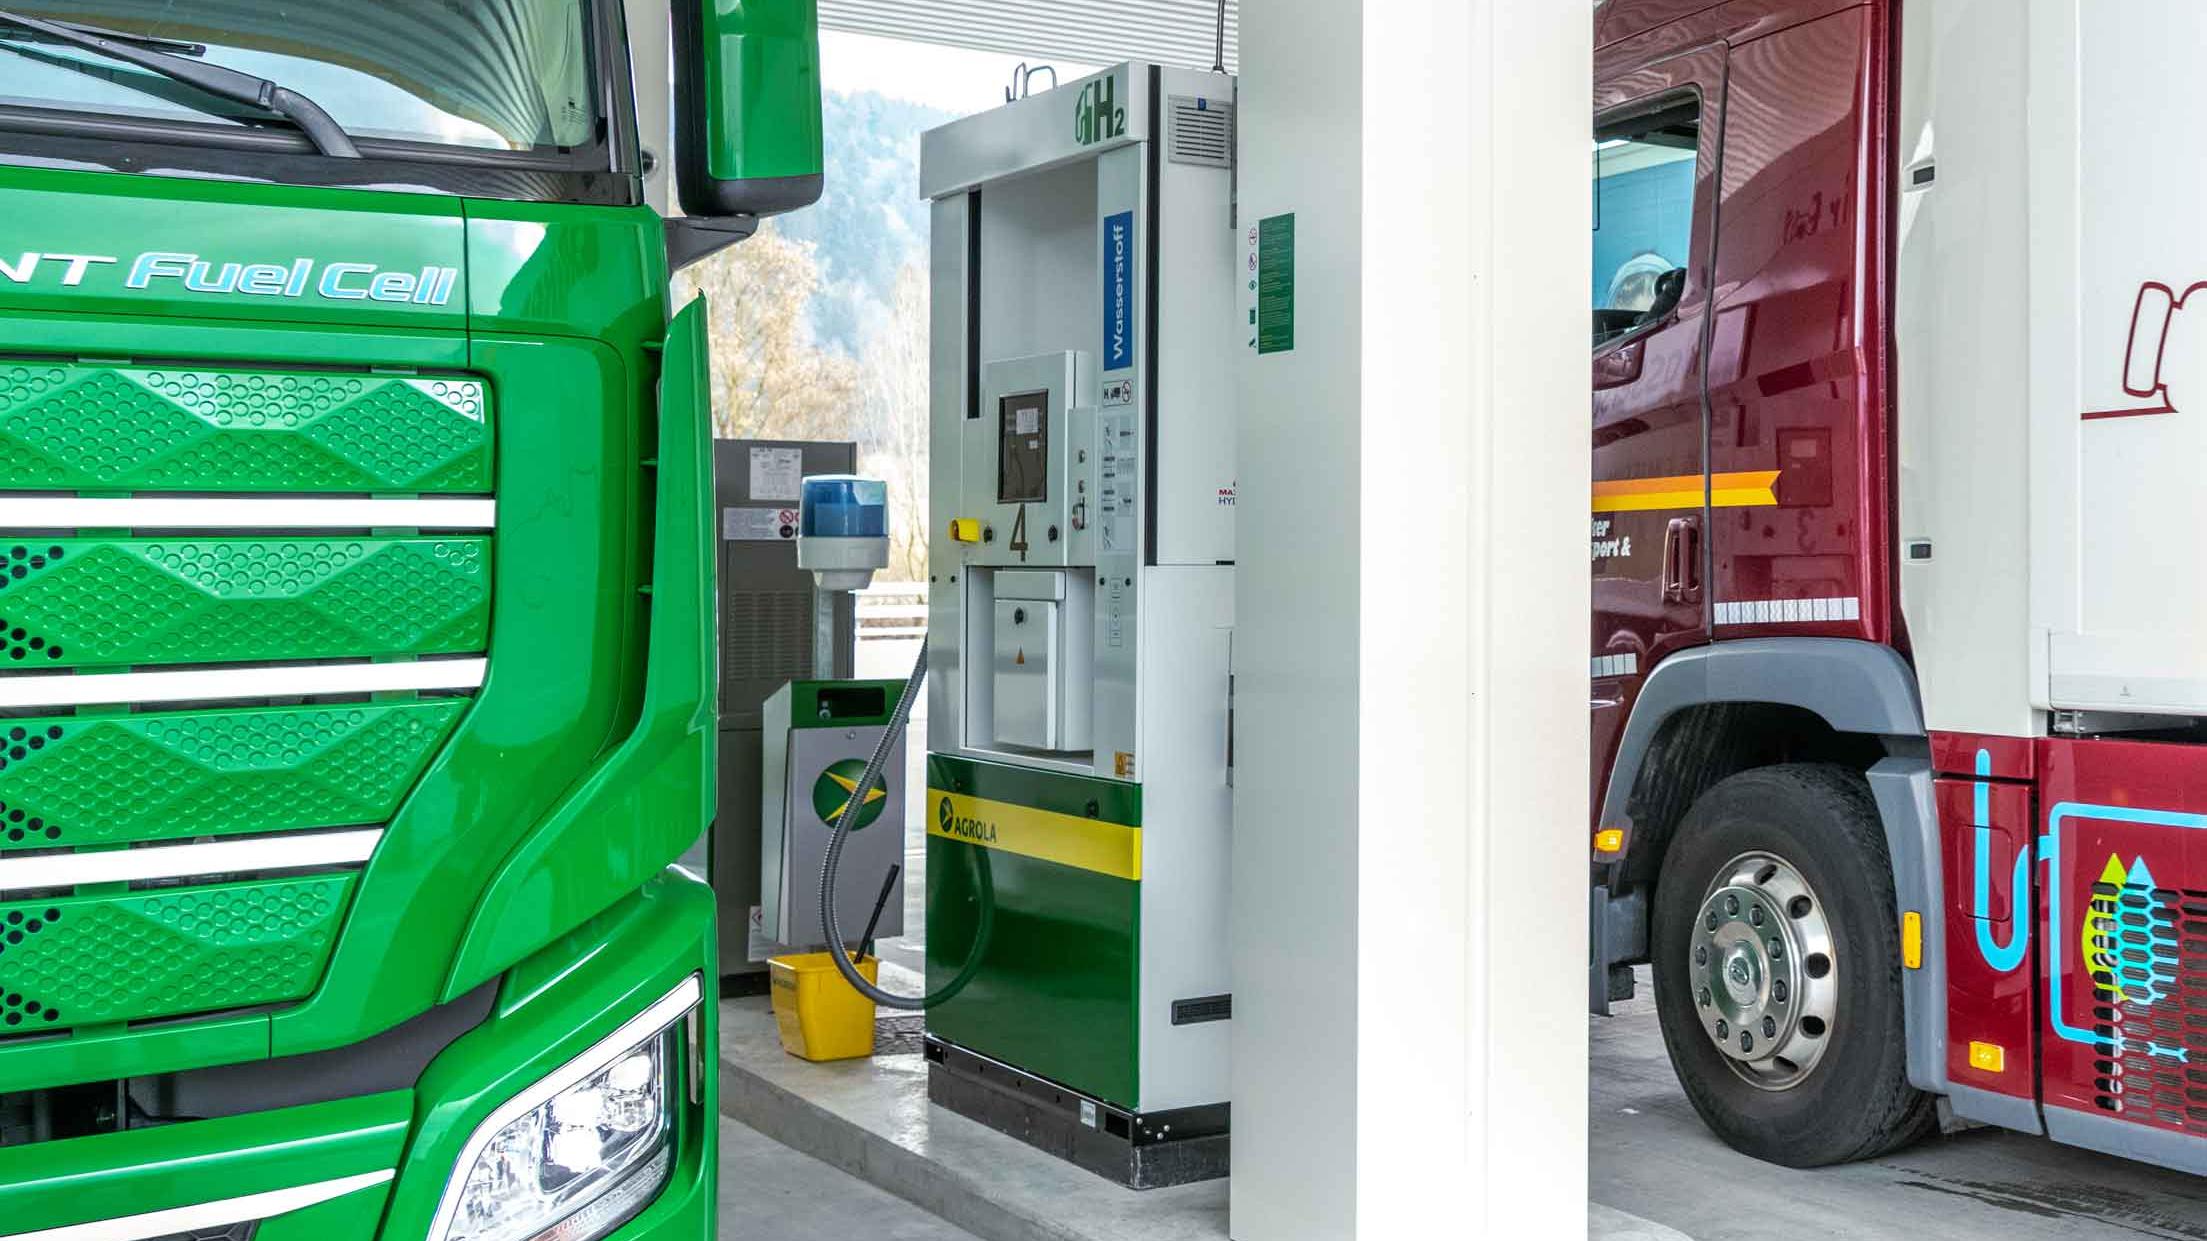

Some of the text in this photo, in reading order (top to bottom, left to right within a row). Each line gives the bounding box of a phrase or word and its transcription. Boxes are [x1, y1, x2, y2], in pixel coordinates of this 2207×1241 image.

[124, 252, 313, 298] Fuel
[317, 262, 458, 306] Cell
[1113, 224, 1125, 360] Wasserstoff
[1010, 502, 1029, 563] 4
[1620, 535, 1632, 557] &
[954, 815, 998, 844] AGROLA
